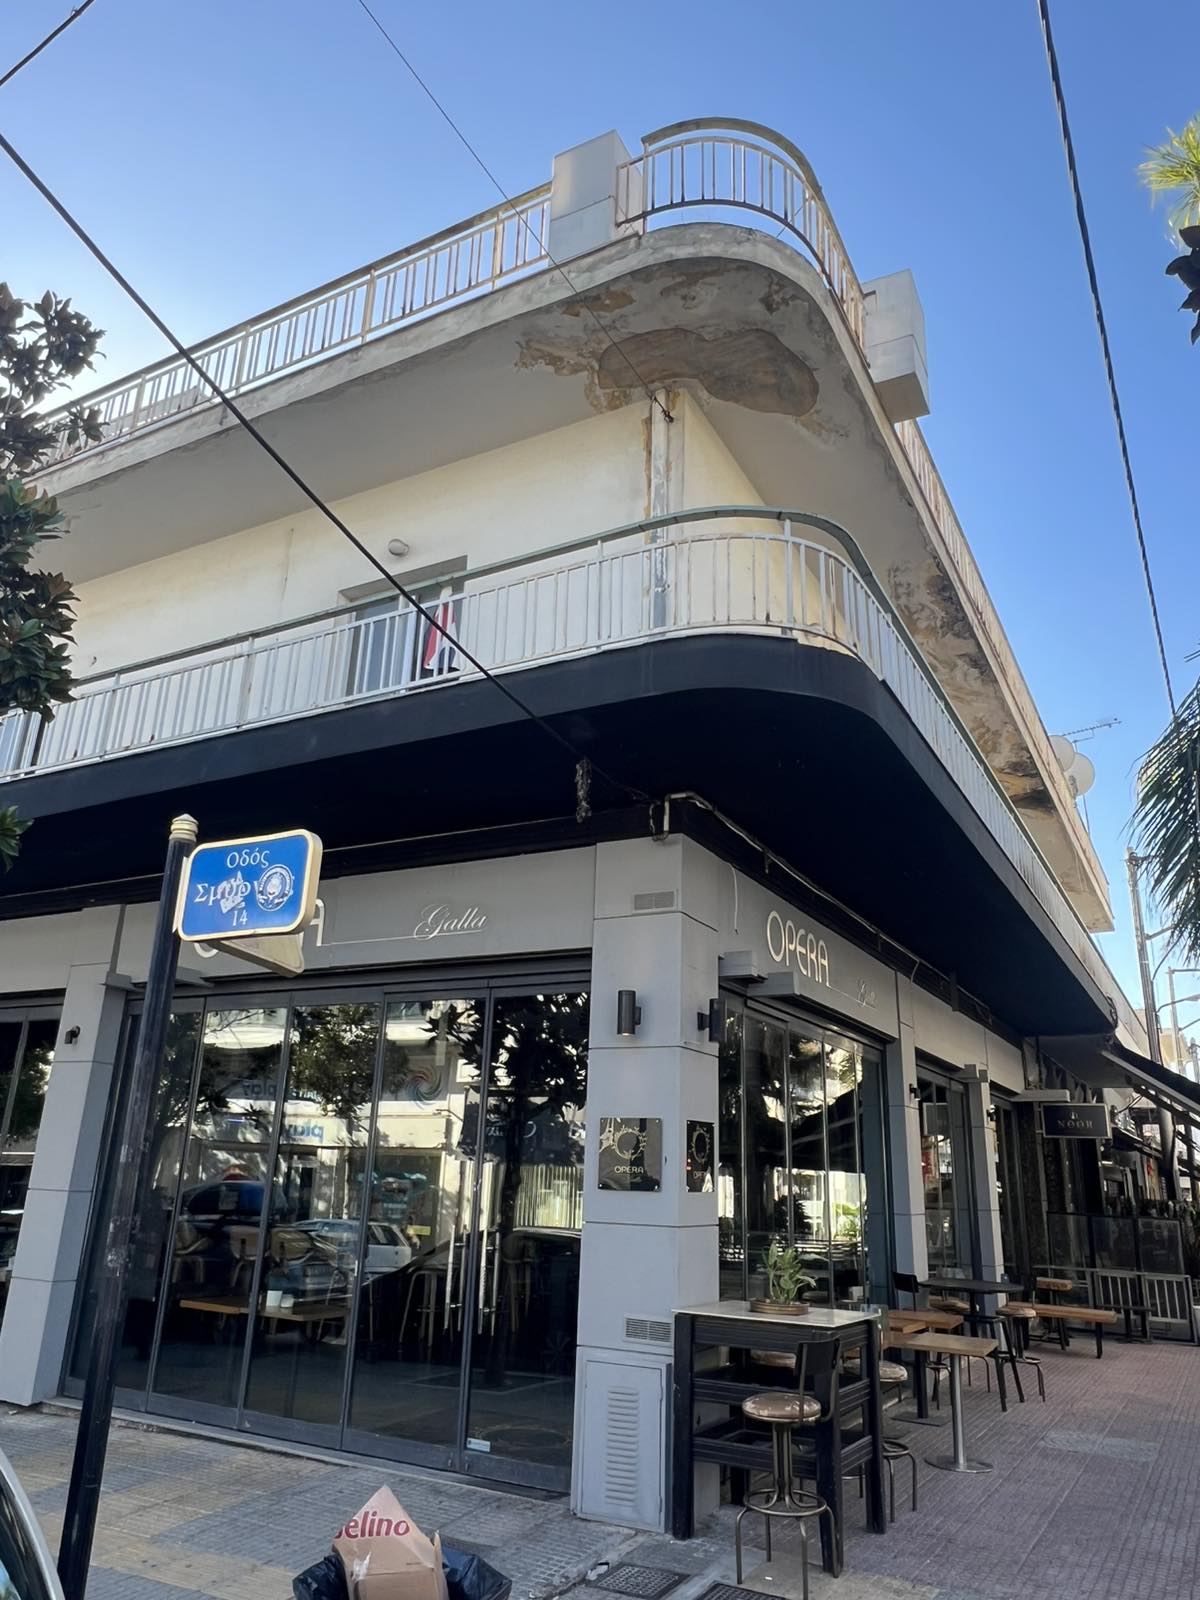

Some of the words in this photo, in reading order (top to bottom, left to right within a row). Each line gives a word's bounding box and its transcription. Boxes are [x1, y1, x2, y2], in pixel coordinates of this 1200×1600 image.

[226, 847, 271, 868] Οδός
[232, 909, 248, 926] 14
[412, 903, 489, 941] Galla
[766, 910, 831, 987] OPERA
[614, 1165, 644, 1174] OPERA
